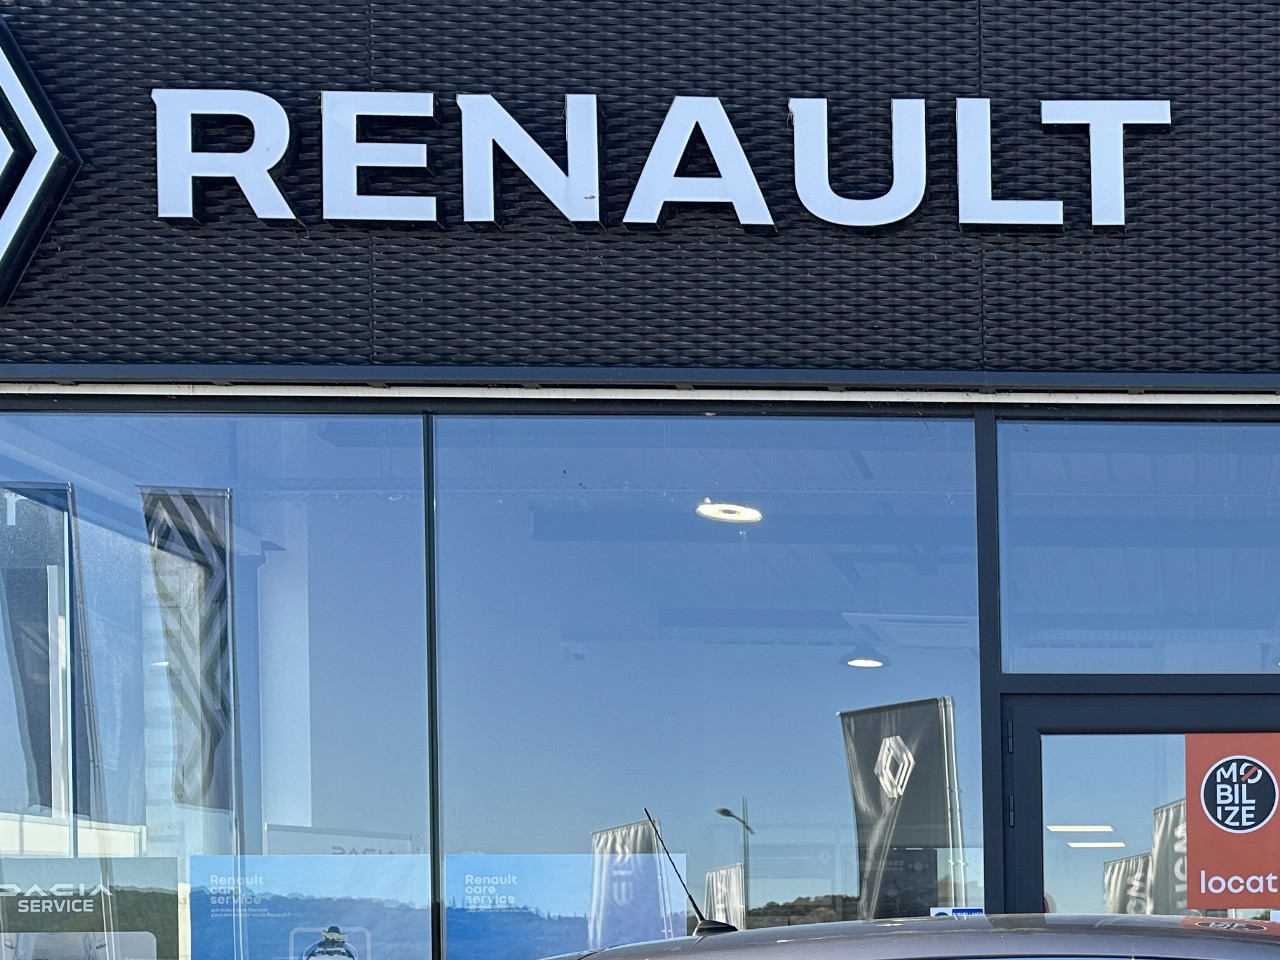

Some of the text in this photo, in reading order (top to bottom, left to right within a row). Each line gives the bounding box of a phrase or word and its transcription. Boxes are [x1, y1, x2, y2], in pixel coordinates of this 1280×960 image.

[152, 87, 1171, 227] RENAULT
[209, 874, 264, 885] Renault
[465, 874, 518, 885] Renault
[0, 883, 113, 897] DACIA
[465, 886, 496, 895] care
[210, 894, 262, 905] service
[465, 893, 516, 904] service
[17, 899, 94, 913] SERVICE
